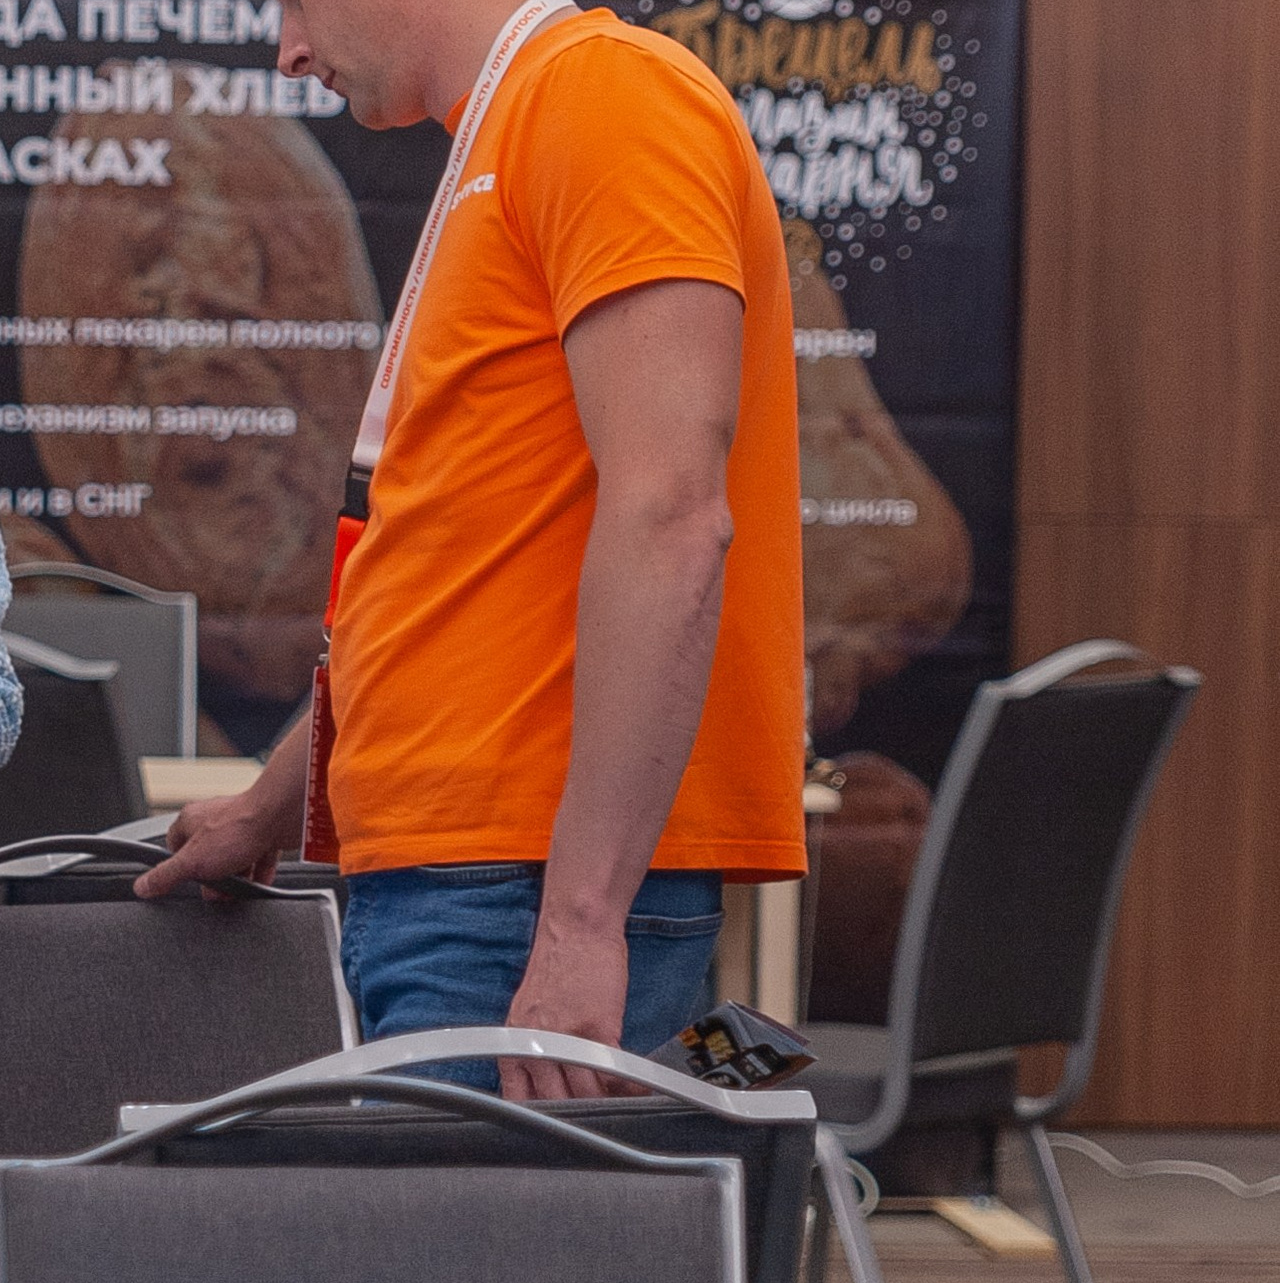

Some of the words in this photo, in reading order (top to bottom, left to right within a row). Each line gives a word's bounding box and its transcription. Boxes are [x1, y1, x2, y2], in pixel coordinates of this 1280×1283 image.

[380, 285, 417, 389] СОВРЕМЕННОСТЬ
[417, 174, 456, 276] ОПЕРАТИВНОСТЬ
[491, 6, 543, 71] ОТКРЫТОСТЬ
[75, 482, 154, 518] СНГ
